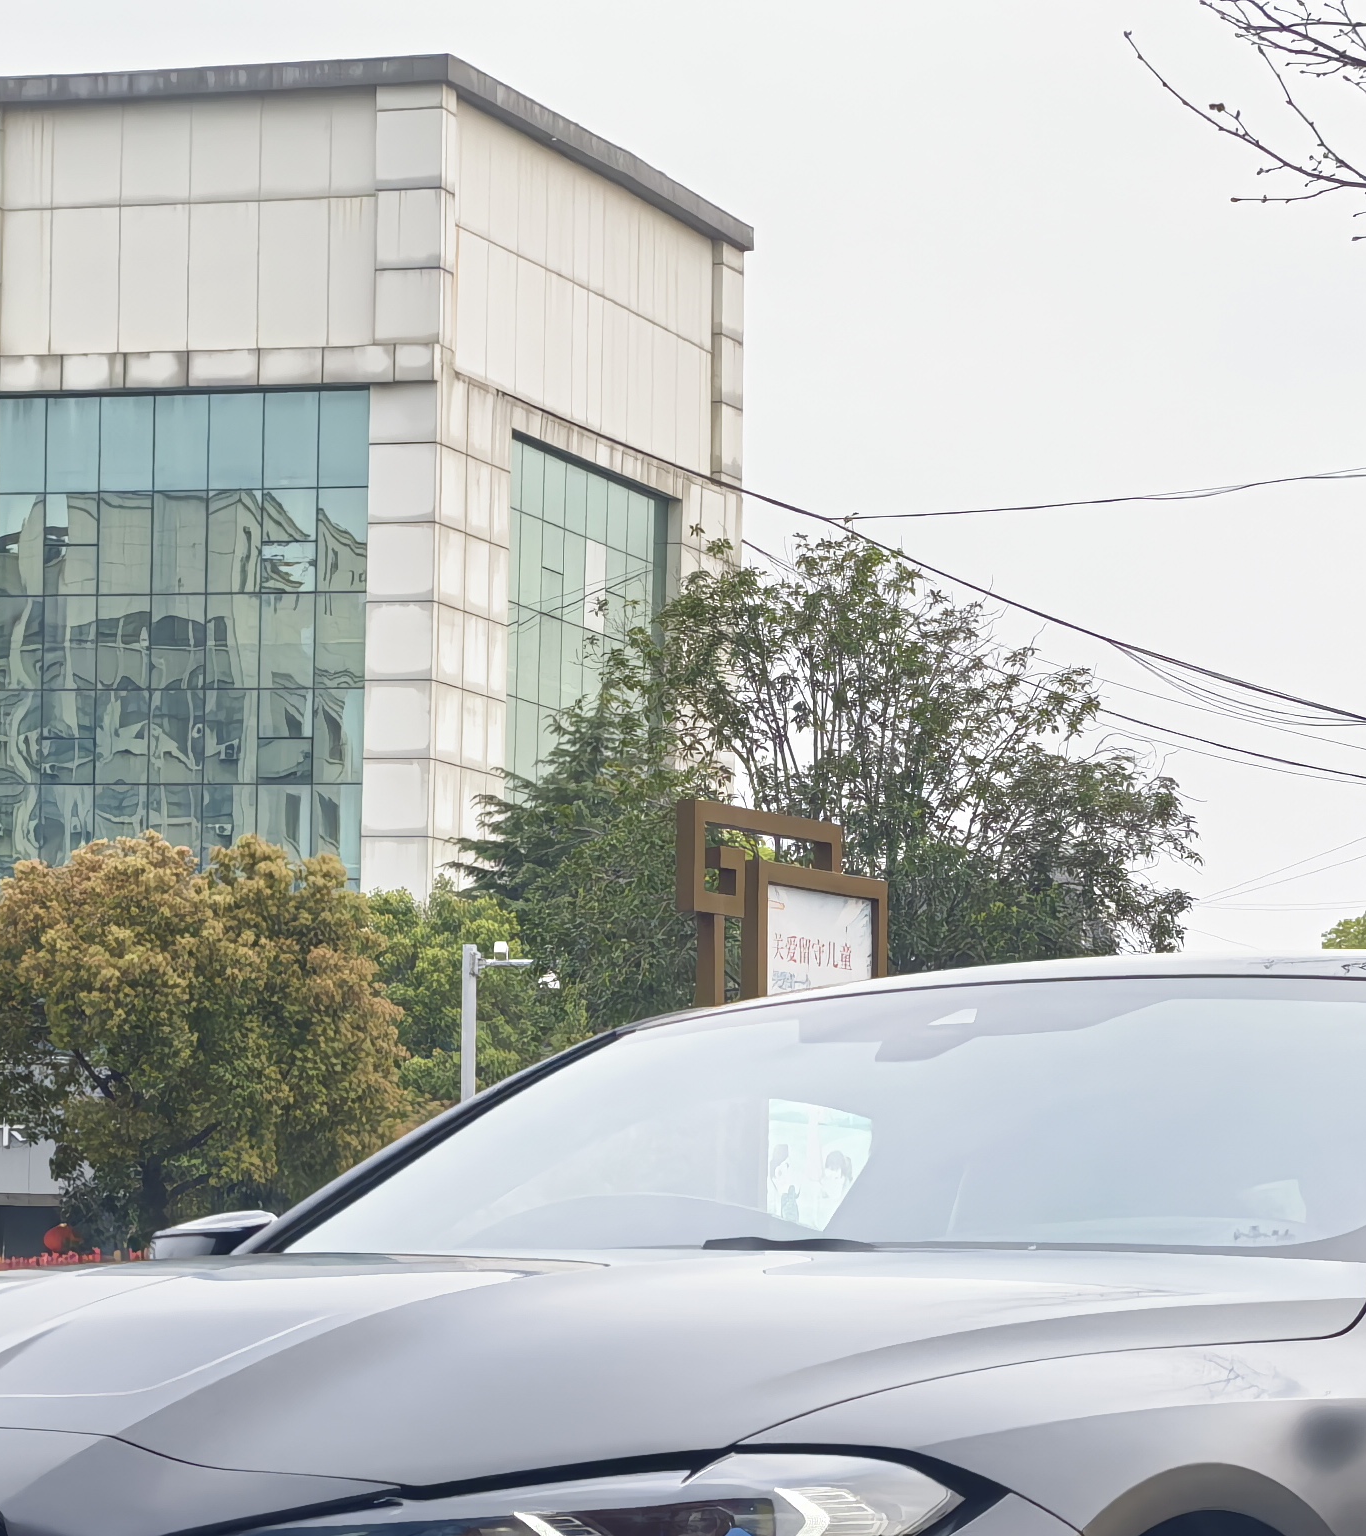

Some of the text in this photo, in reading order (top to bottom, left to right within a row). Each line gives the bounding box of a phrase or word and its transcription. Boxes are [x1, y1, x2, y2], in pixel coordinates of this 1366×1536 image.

[772, 932, 853, 971] 关爱留守儿童
